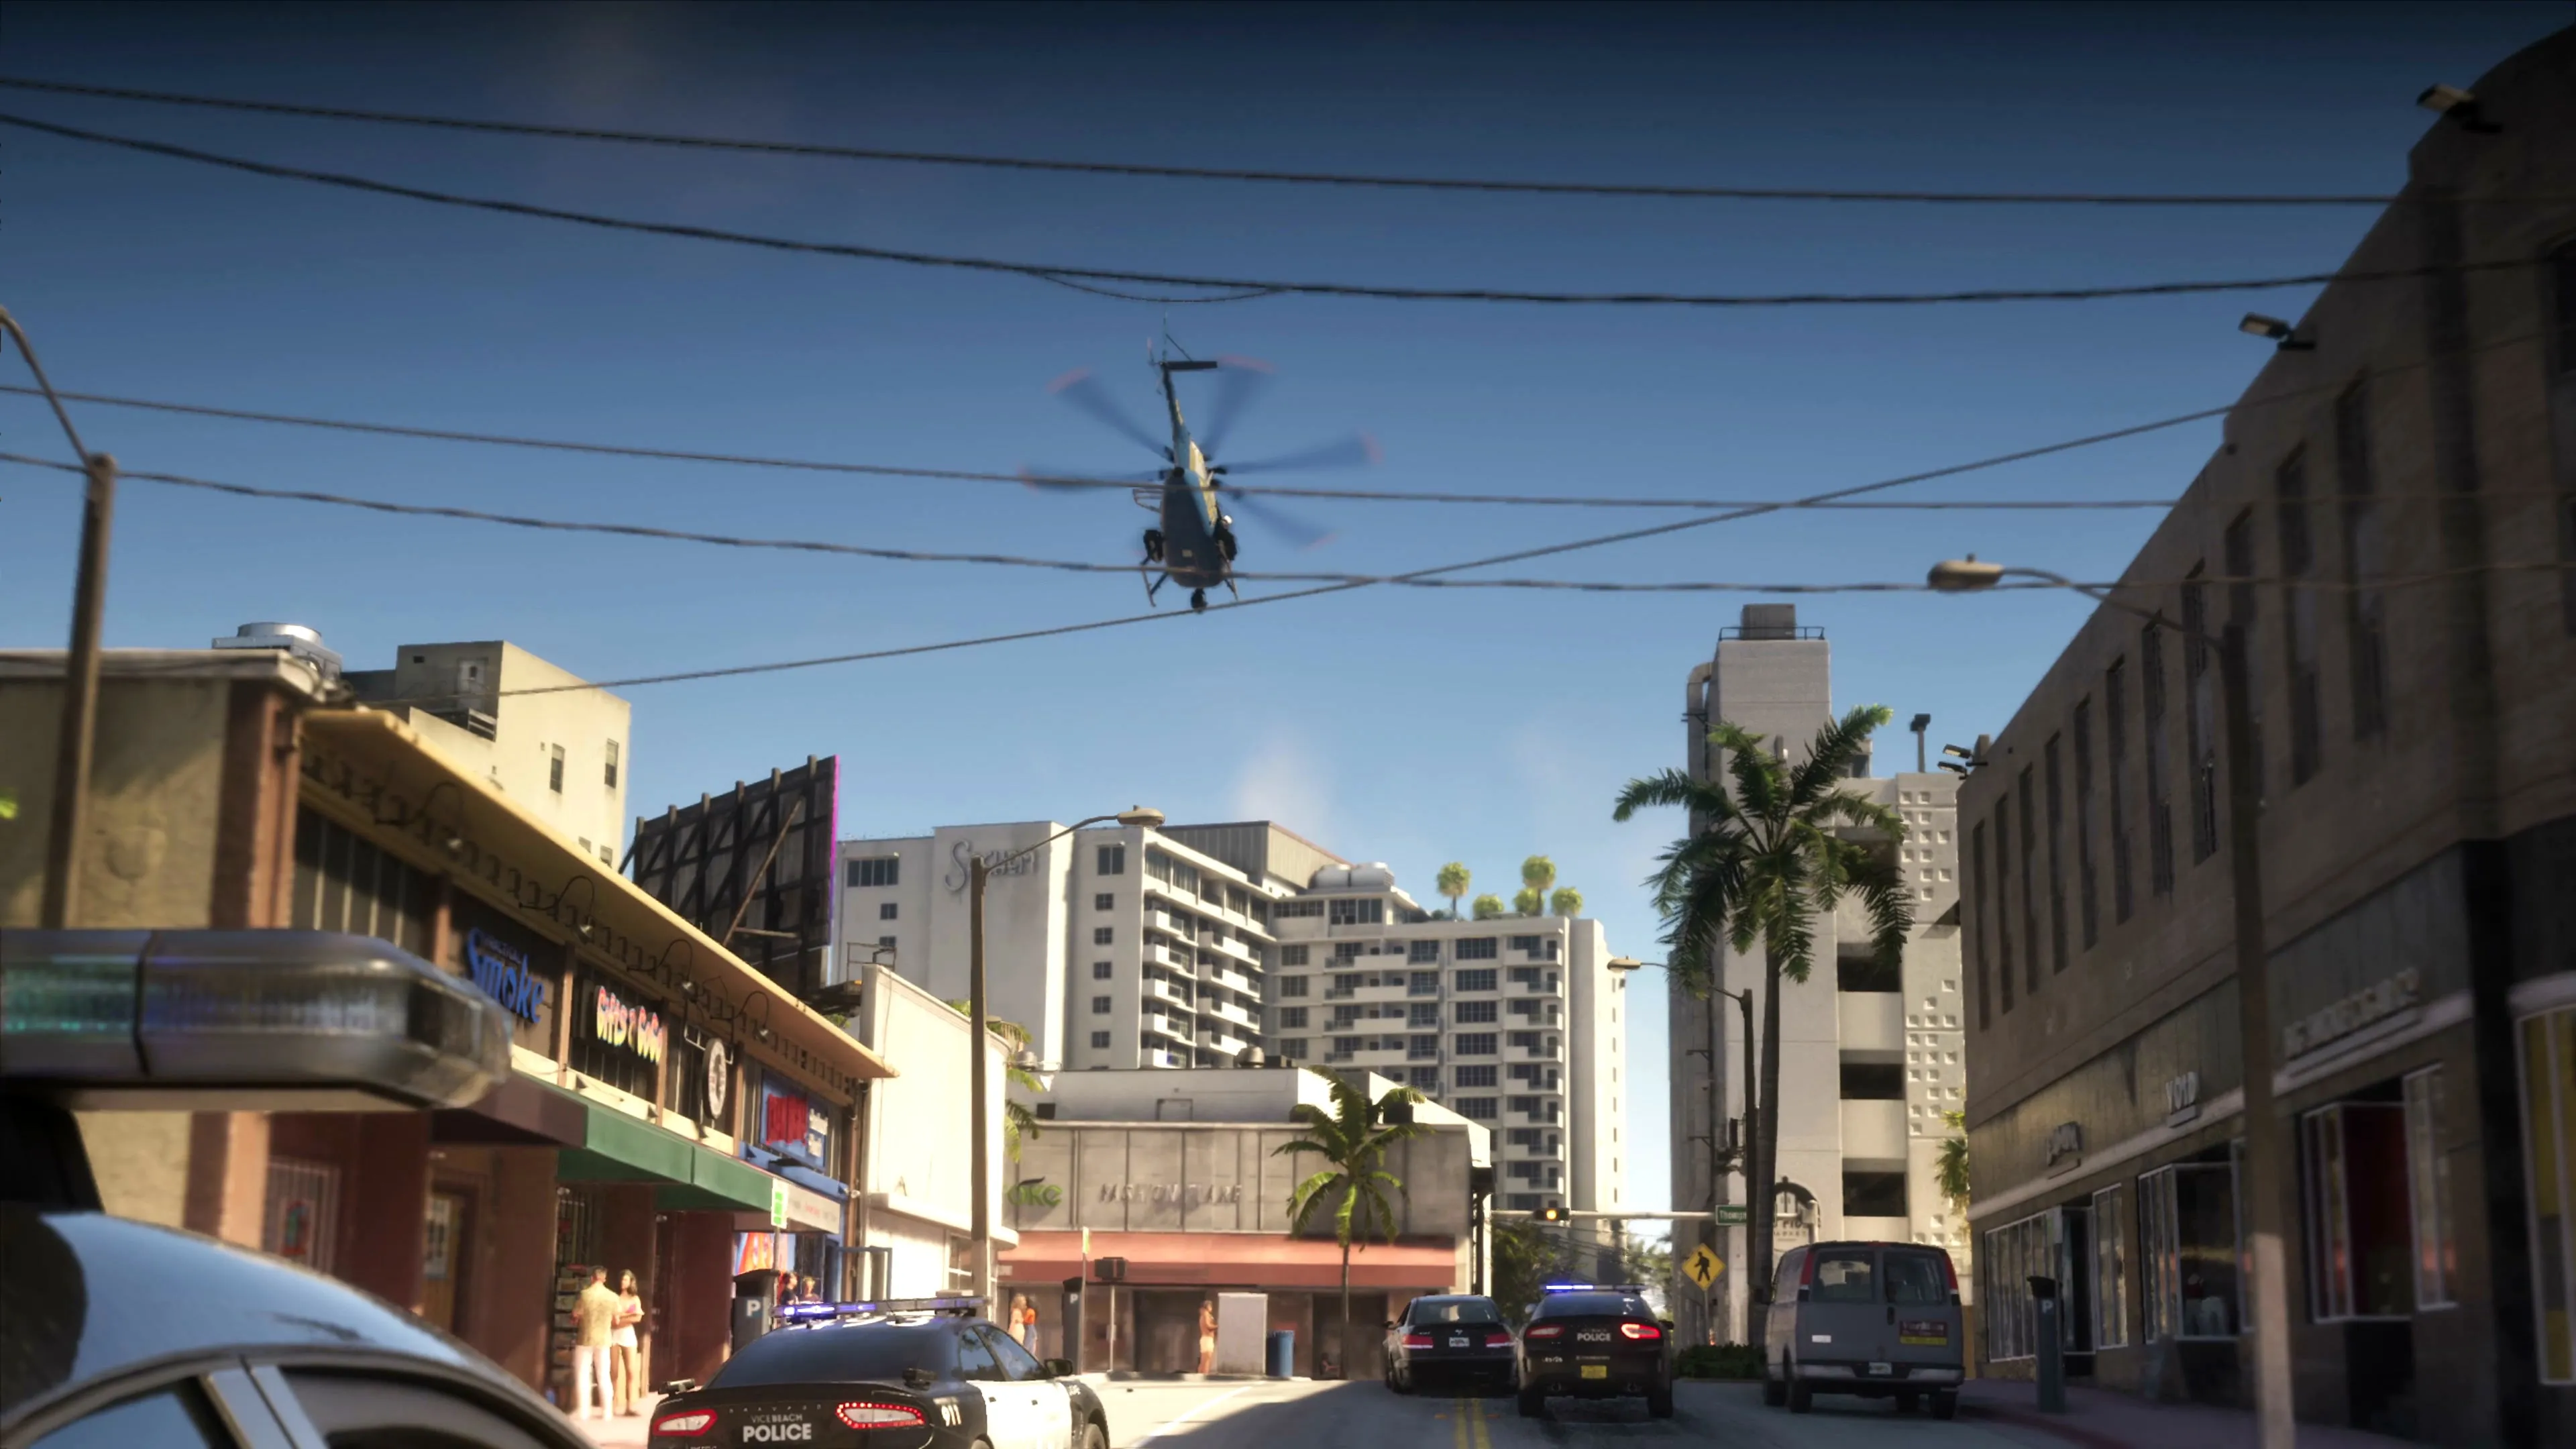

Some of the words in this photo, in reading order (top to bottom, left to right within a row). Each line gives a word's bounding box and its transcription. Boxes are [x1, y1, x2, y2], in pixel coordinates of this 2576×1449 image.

[467, 927, 545, 1023] Smoke
[1070, 1293, 1078, 1303] P
[747, 1299, 761, 1316] P
[2042, 1299, 2053, 1313] P
[1576, 1332, 1611, 1342] POLICE
[751, 1414, 770, 1423] VICE
[771, 1413, 803, 1422] BEACH
[941, 1403, 962, 1427] 911
[743, 1423, 812, 1443] POLICE
